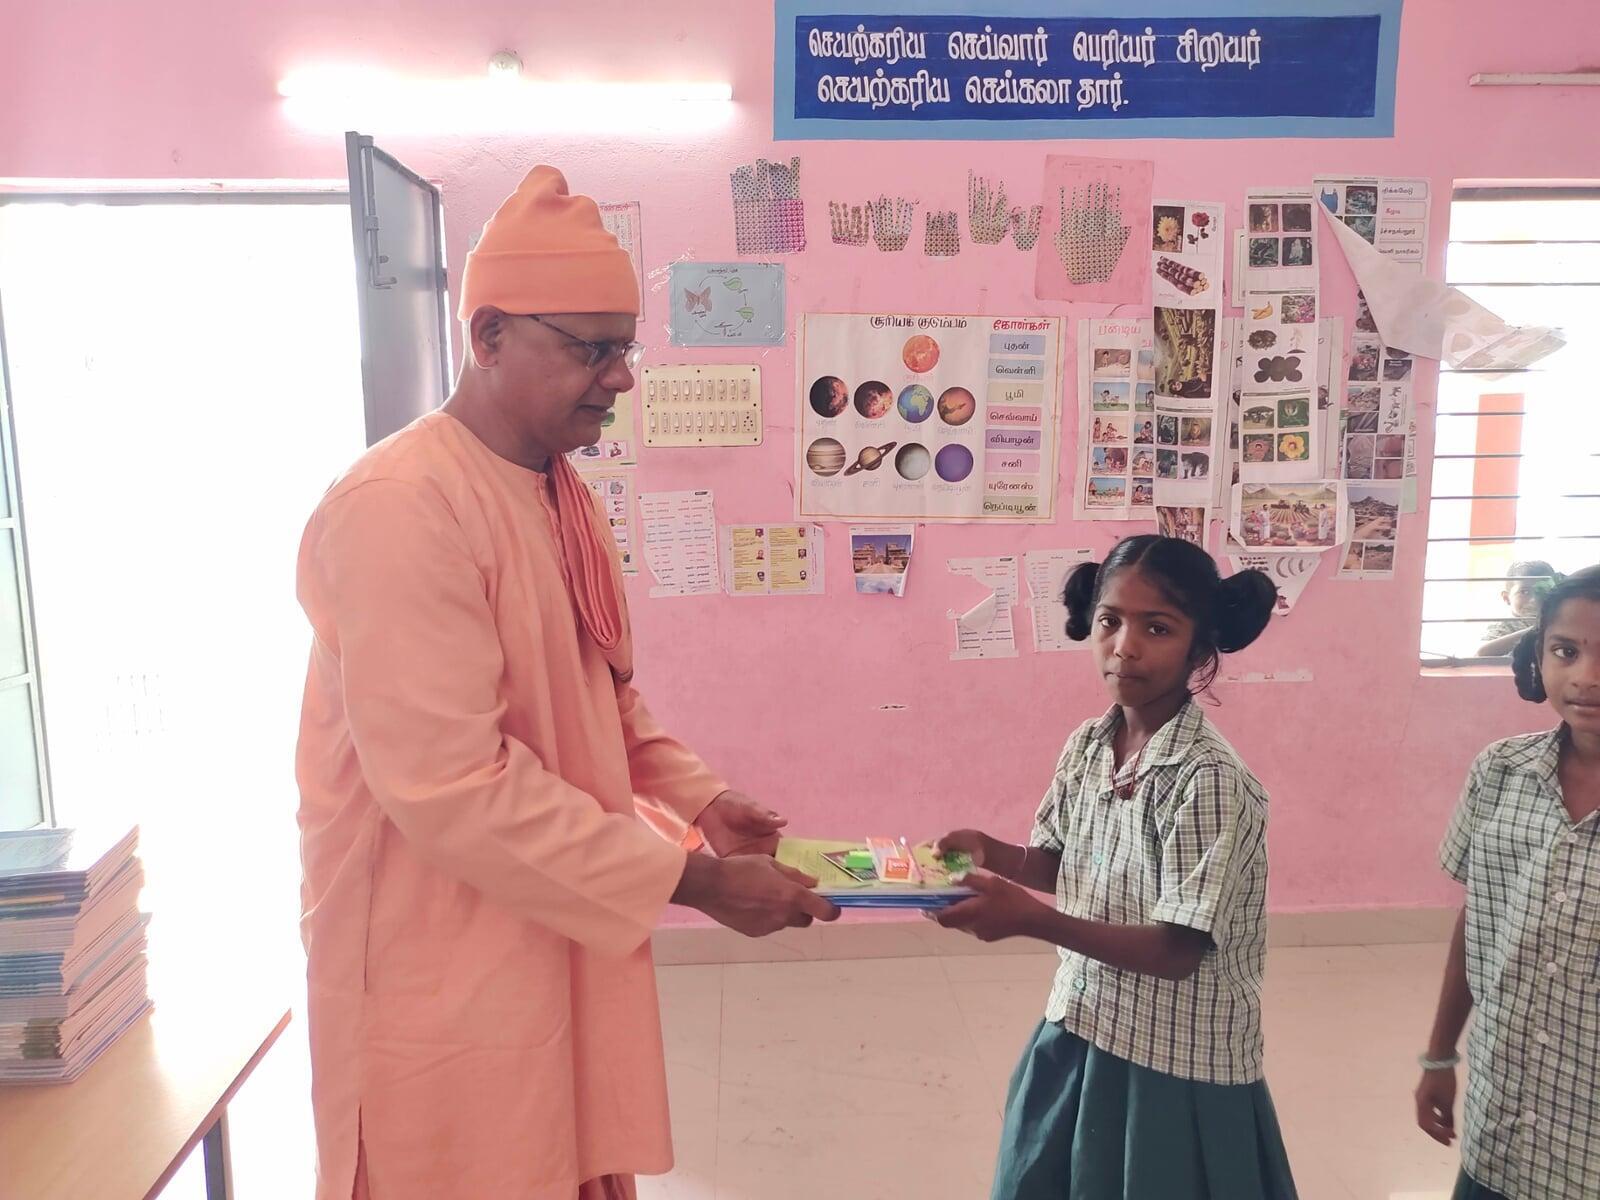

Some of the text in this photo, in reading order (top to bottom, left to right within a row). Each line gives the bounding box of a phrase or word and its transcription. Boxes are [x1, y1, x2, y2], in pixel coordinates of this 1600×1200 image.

[809, 24, 1261, 72] செயற்கரிய செய்வார் பெரியர் சிறியர்
[818, 68, 950, 111] செயற்கரிய
[993, 318, 1051, 331] கோள்கள்
[1004, 342, 1030, 351] புதன்
[995, 365, 1036, 375] வெள்ளி
[1005, 389, 1024, 401] பூமி
[989, 411, 1038, 422] செவ்வாய்
[990, 434, 1034, 446] வியாழன்
[1001, 459, 1022, 468] சனி
[988, 480, 1033, 491] யுரேனஸ்
